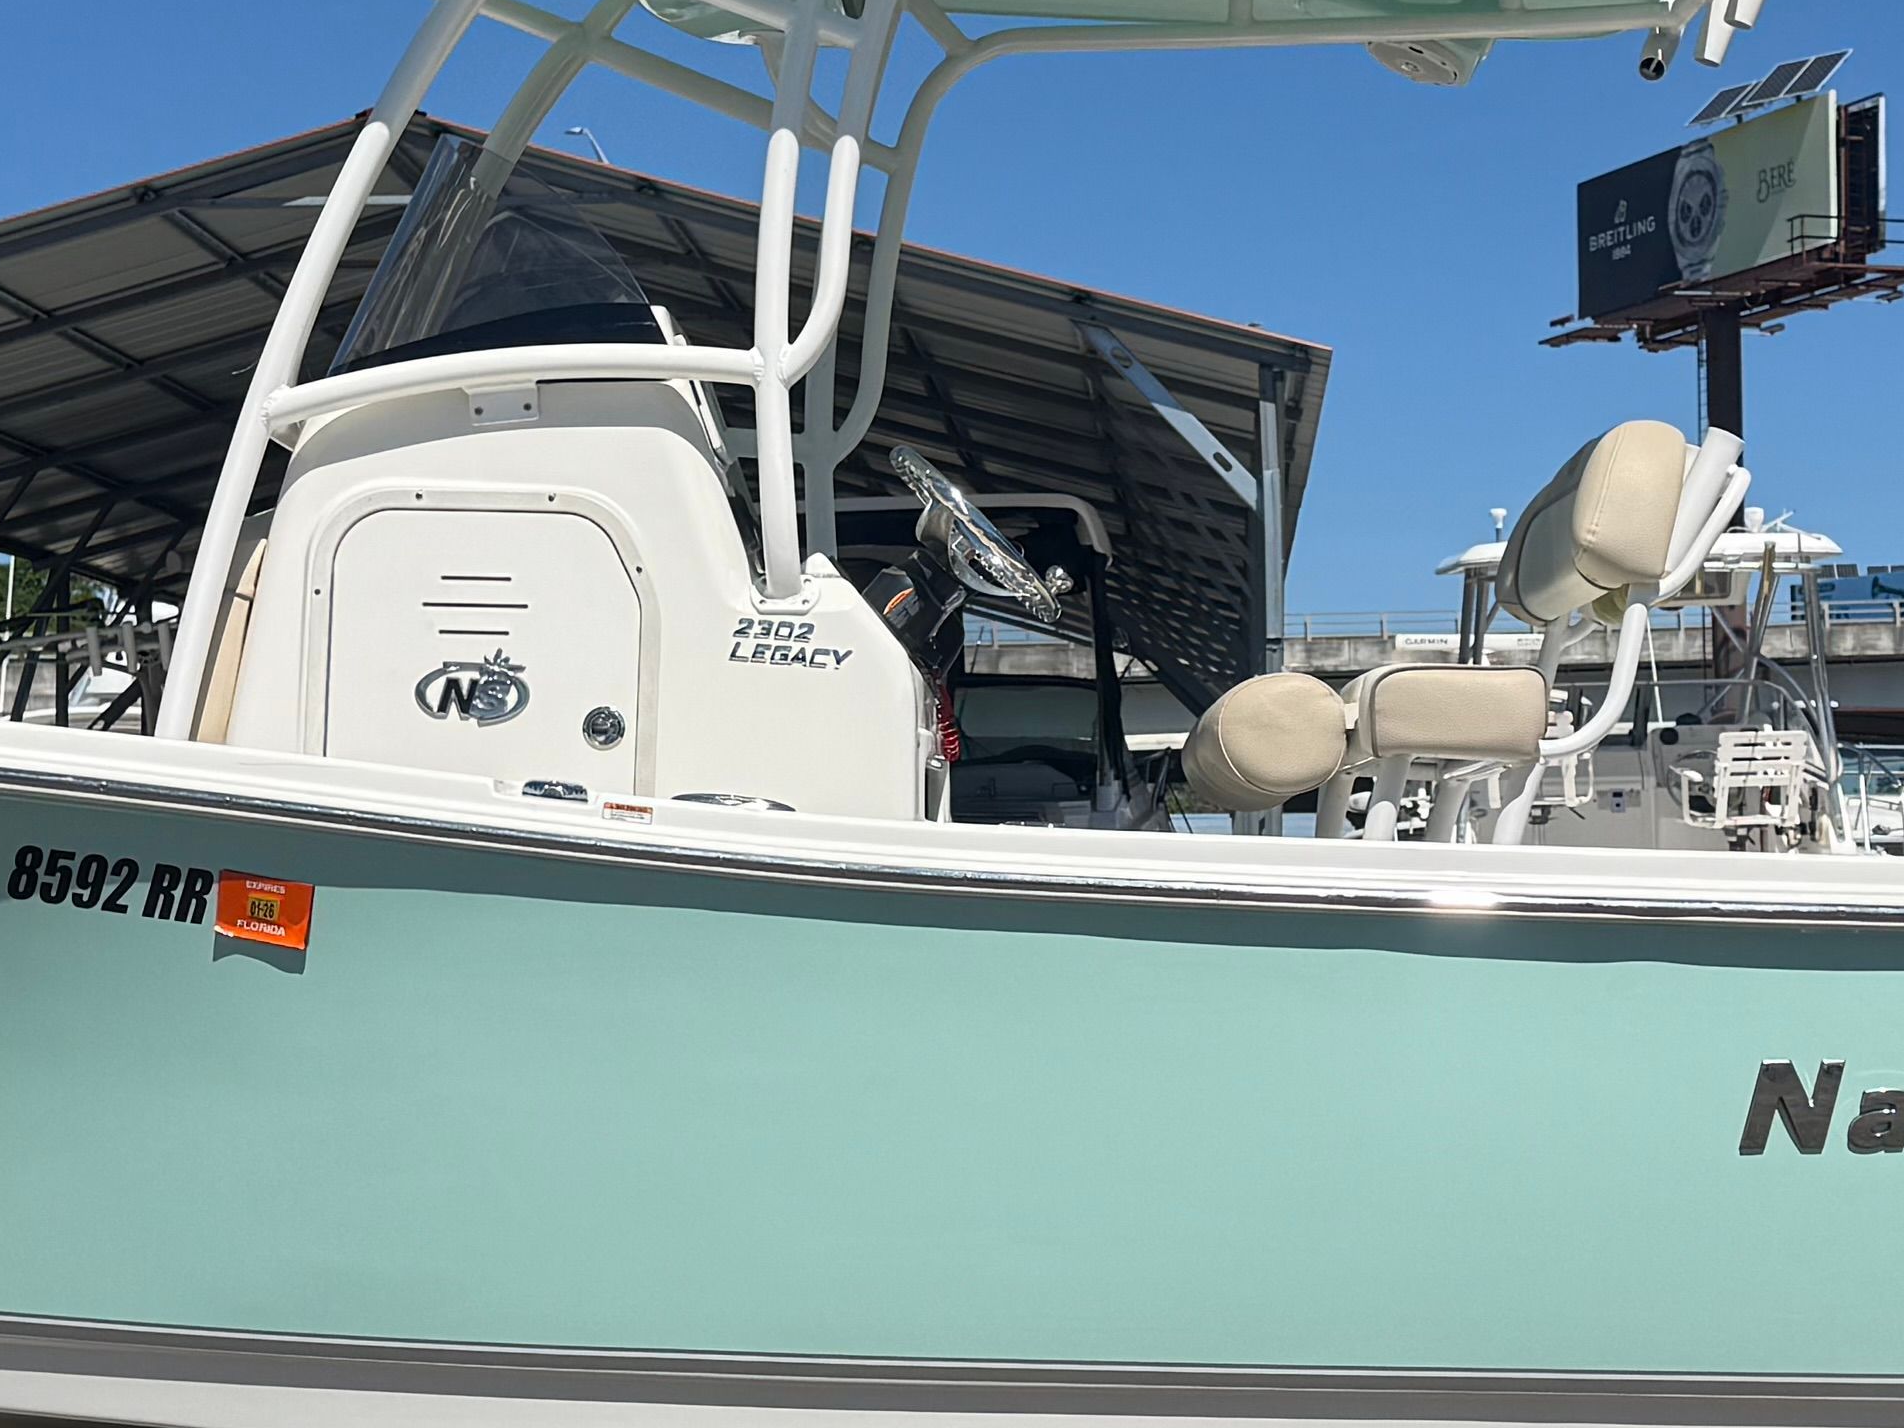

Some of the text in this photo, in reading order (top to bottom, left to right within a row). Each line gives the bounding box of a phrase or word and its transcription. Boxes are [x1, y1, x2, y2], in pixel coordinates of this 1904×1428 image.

[1589, 216, 1656, 252] BREITLING
[732, 617, 815, 643] 2302
[729, 641, 853, 670] LEGACY
[7, 844, 140, 914] 8592
[142, 863, 215, 925] RR
[237, 919, 285, 937] FLORIDA
